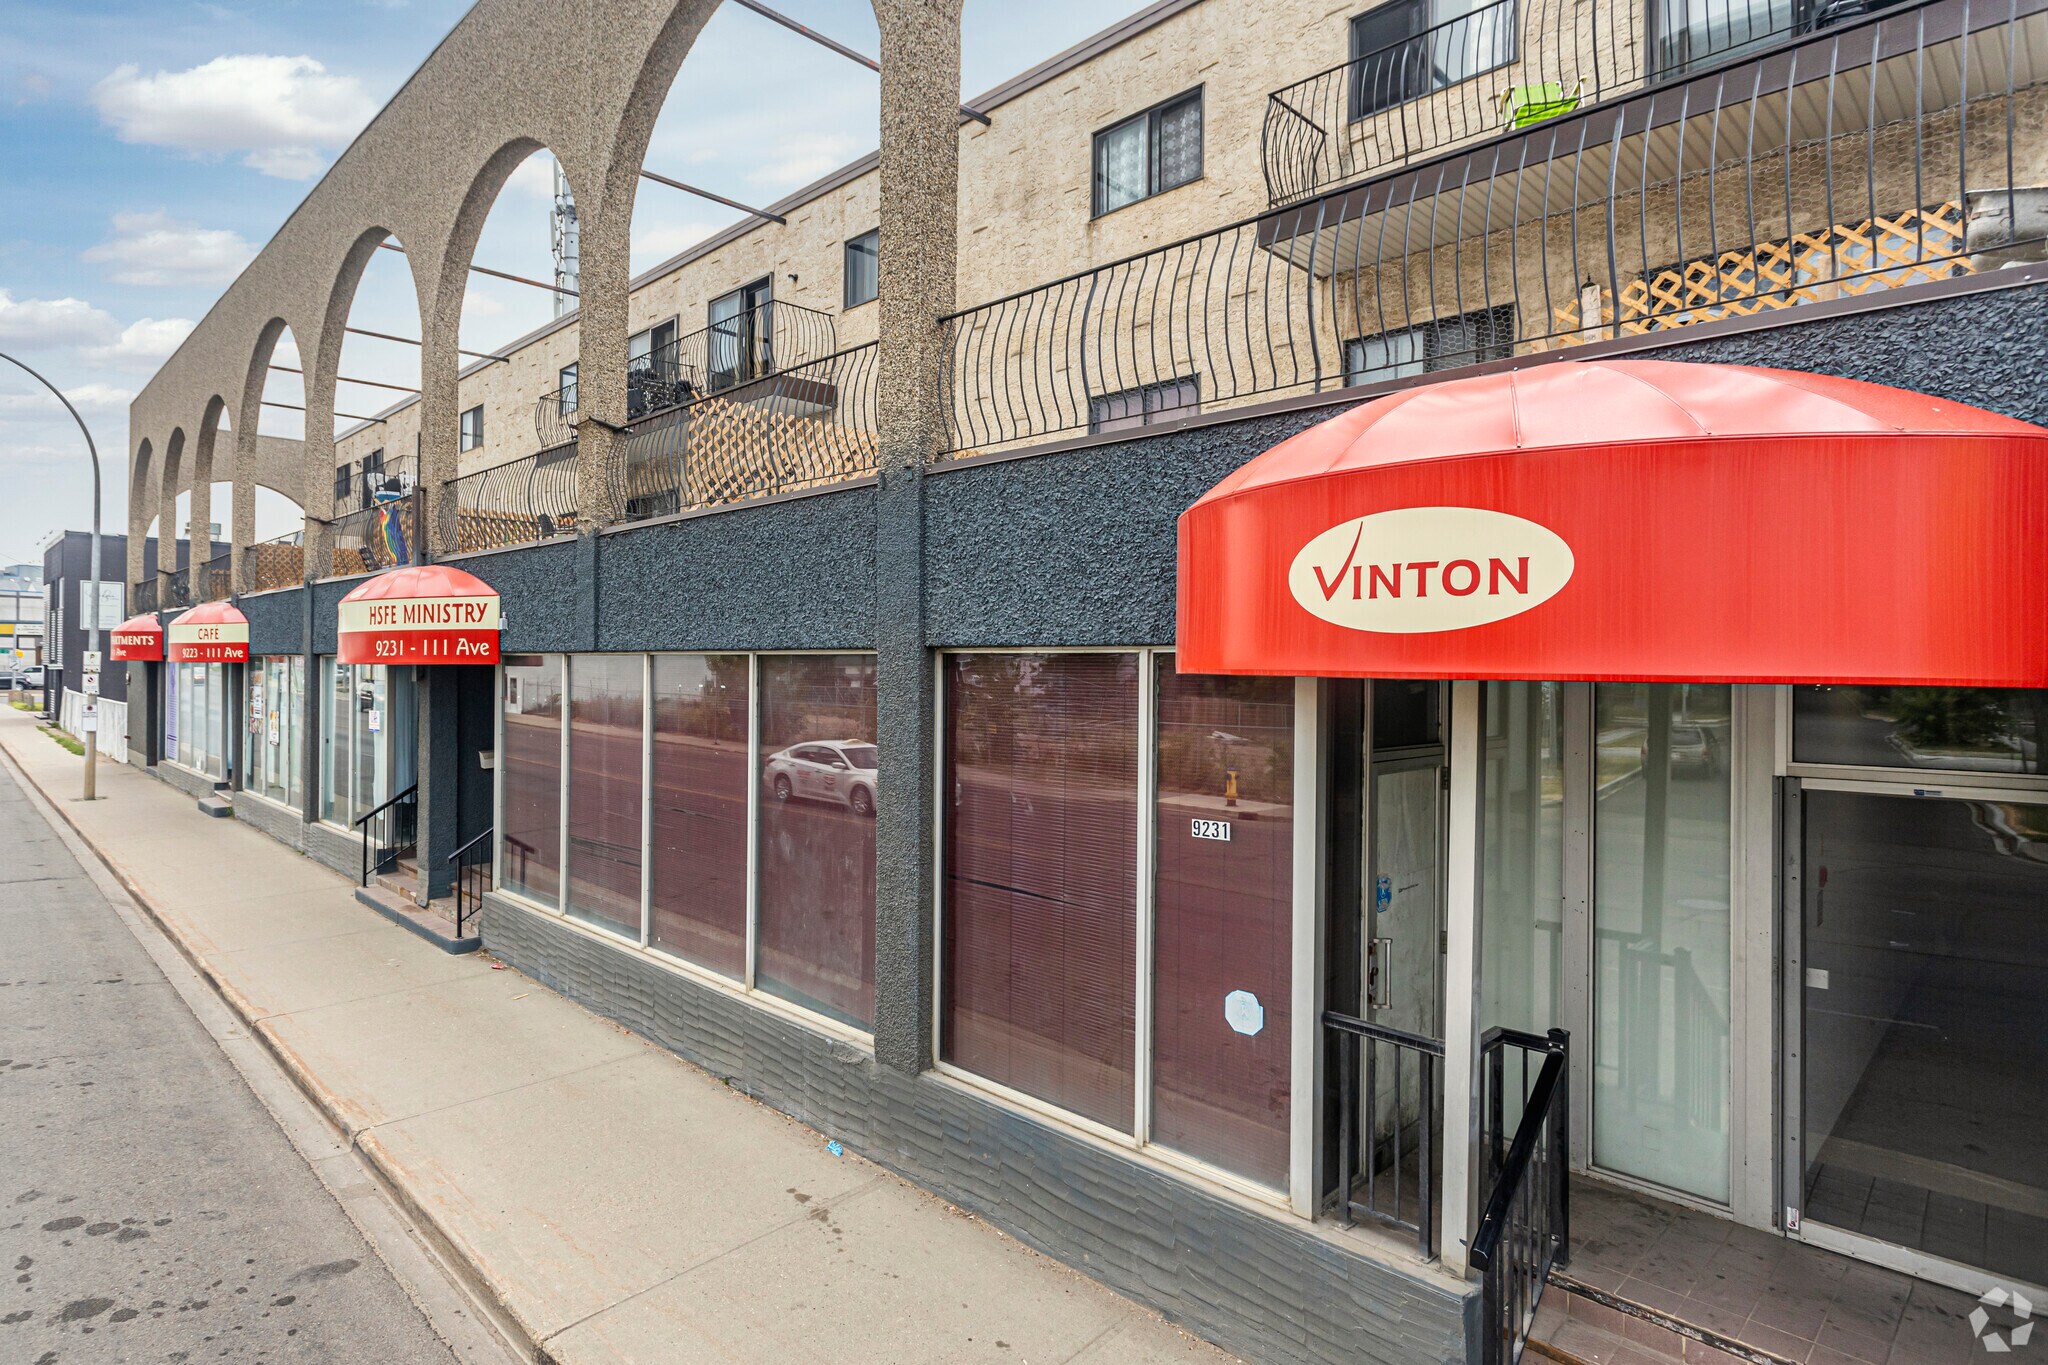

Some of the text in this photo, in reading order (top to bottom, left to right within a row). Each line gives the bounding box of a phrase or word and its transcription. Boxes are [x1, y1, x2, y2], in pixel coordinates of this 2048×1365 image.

[1312, 520, 1530, 602] VINTON
[369, 602, 488, 625] HSFE MINISTRY
[182, 647, 199, 658] 9223
[206, 647, 221, 658] 111
[224, 646, 244, 658] Ave
[375, 639, 404, 657] 9231
[423, 639, 448, 656] 111
[456, 637, 490, 656] Ave
[1193, 820, 1228, 839] 9231
